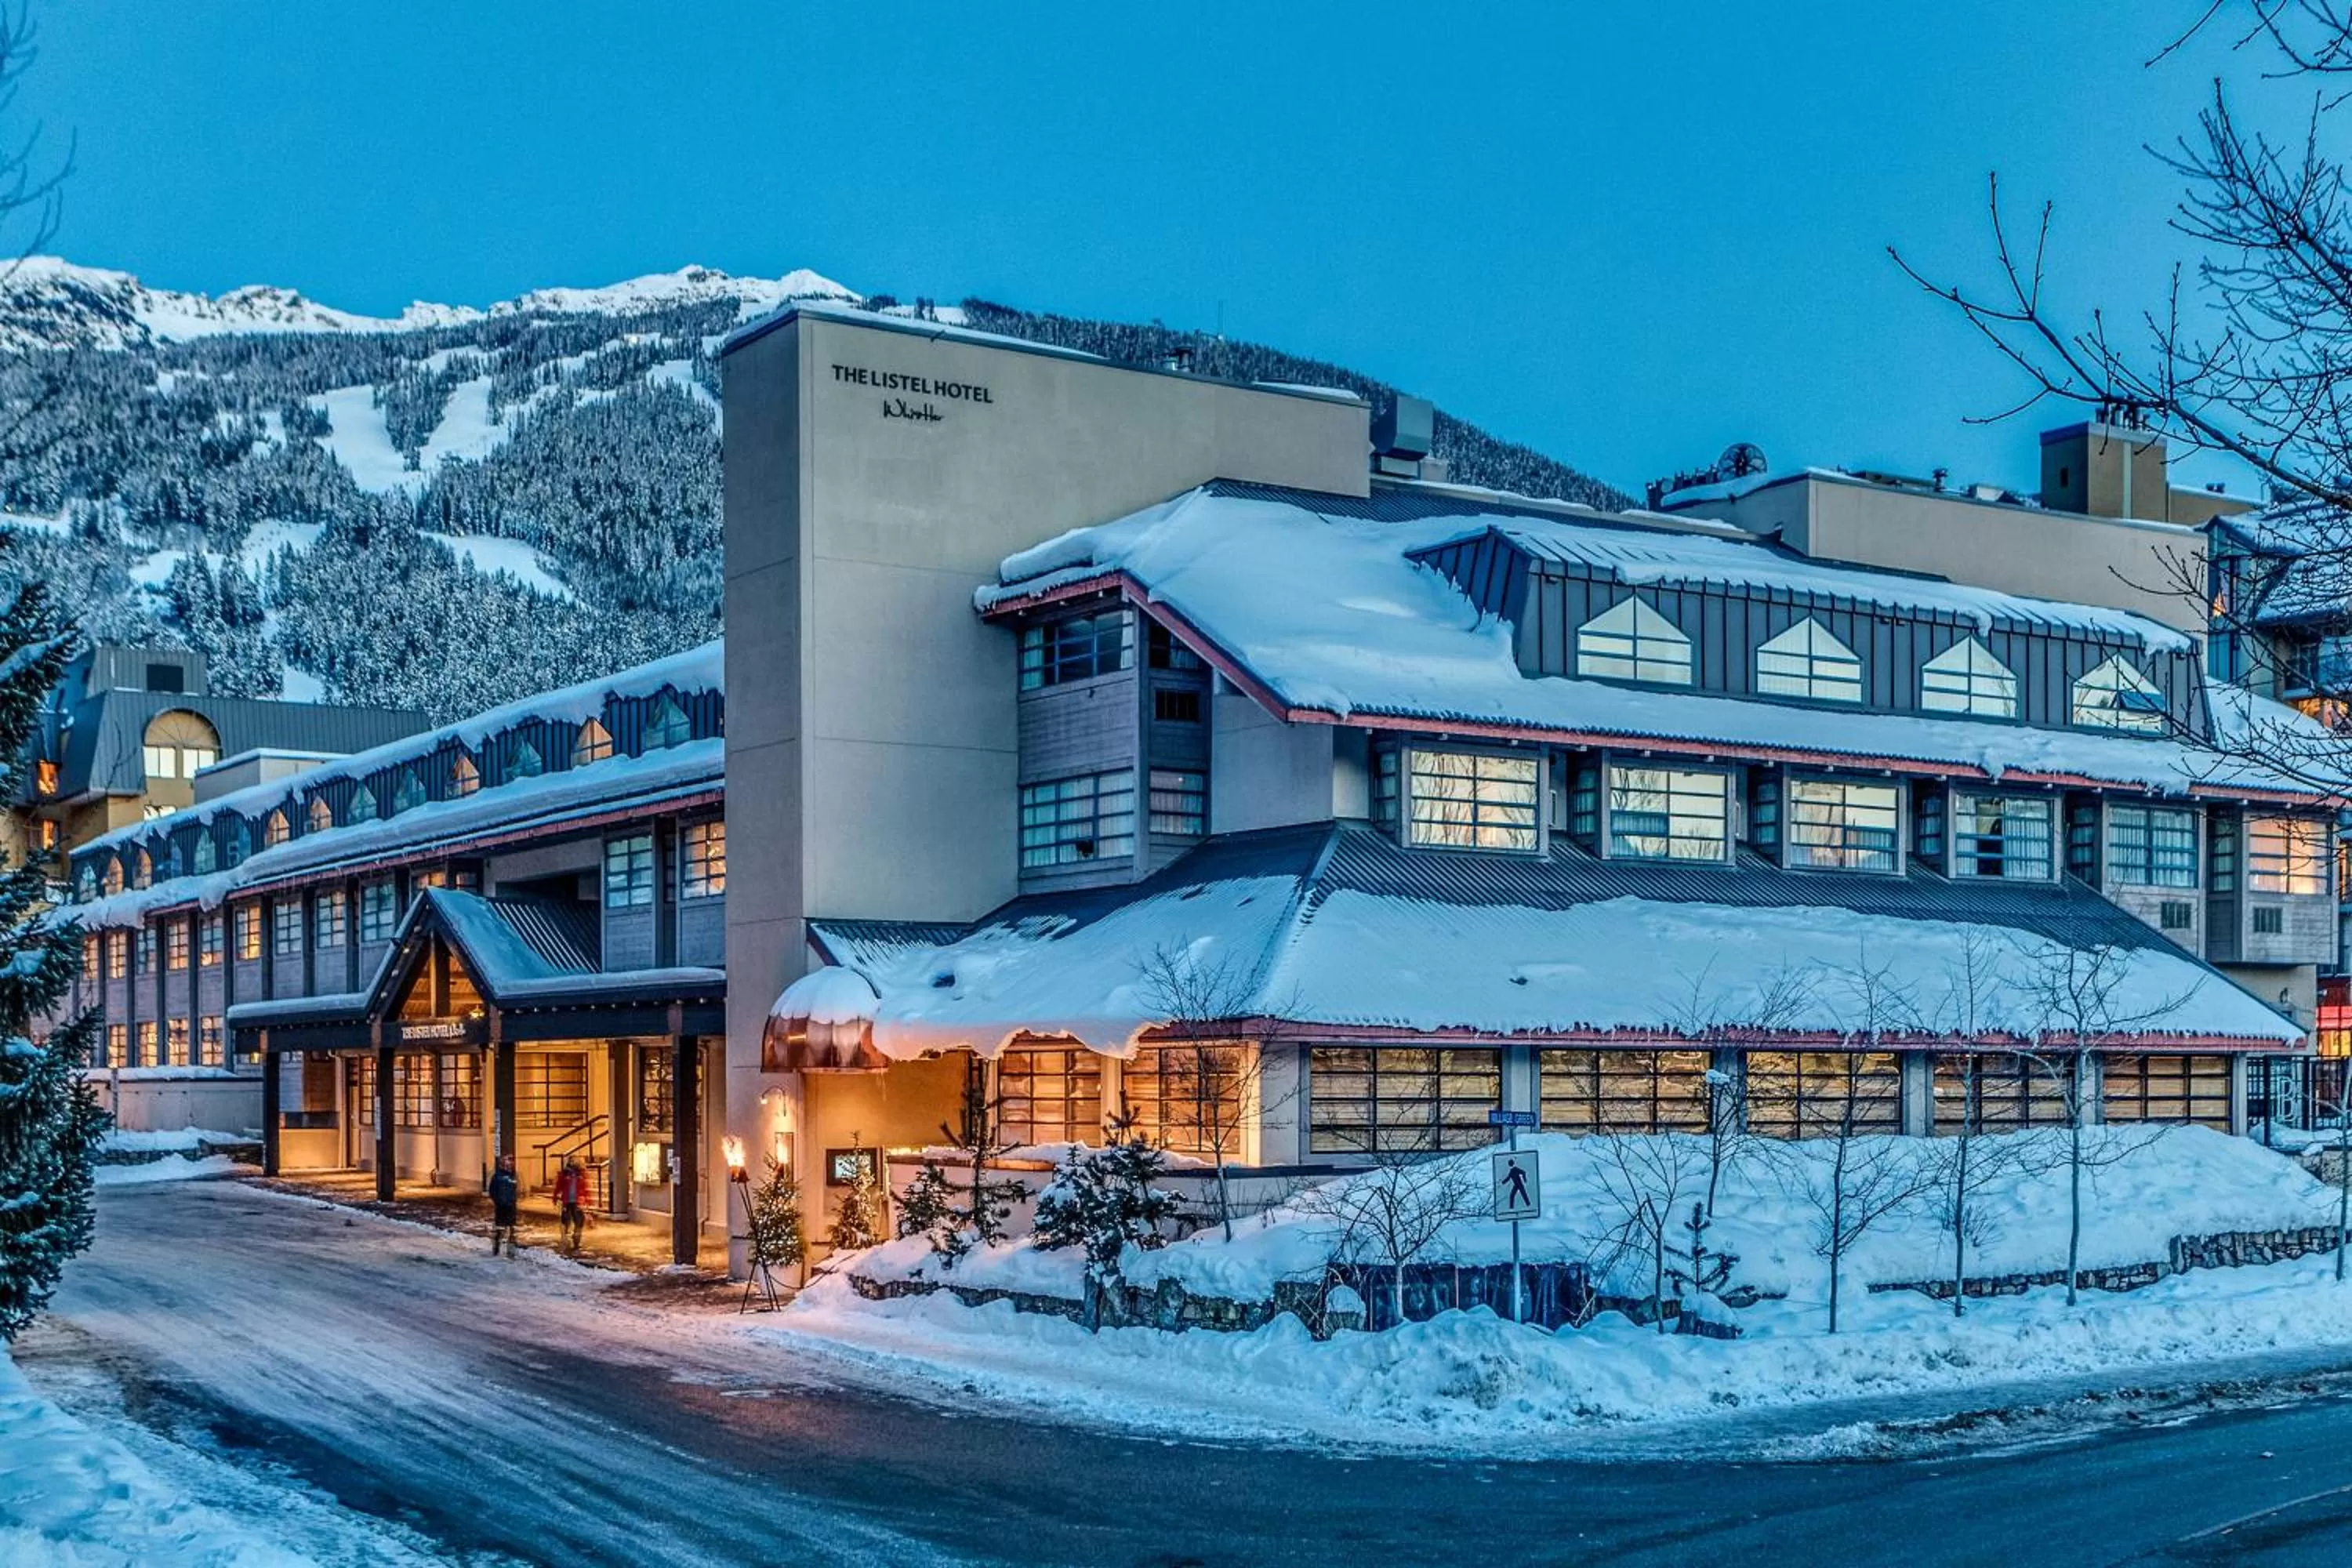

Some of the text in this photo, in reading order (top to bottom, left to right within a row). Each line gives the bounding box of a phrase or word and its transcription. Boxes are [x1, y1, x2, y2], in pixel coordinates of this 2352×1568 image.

[832, 364, 994, 404] THE LISTEL HOTEL
